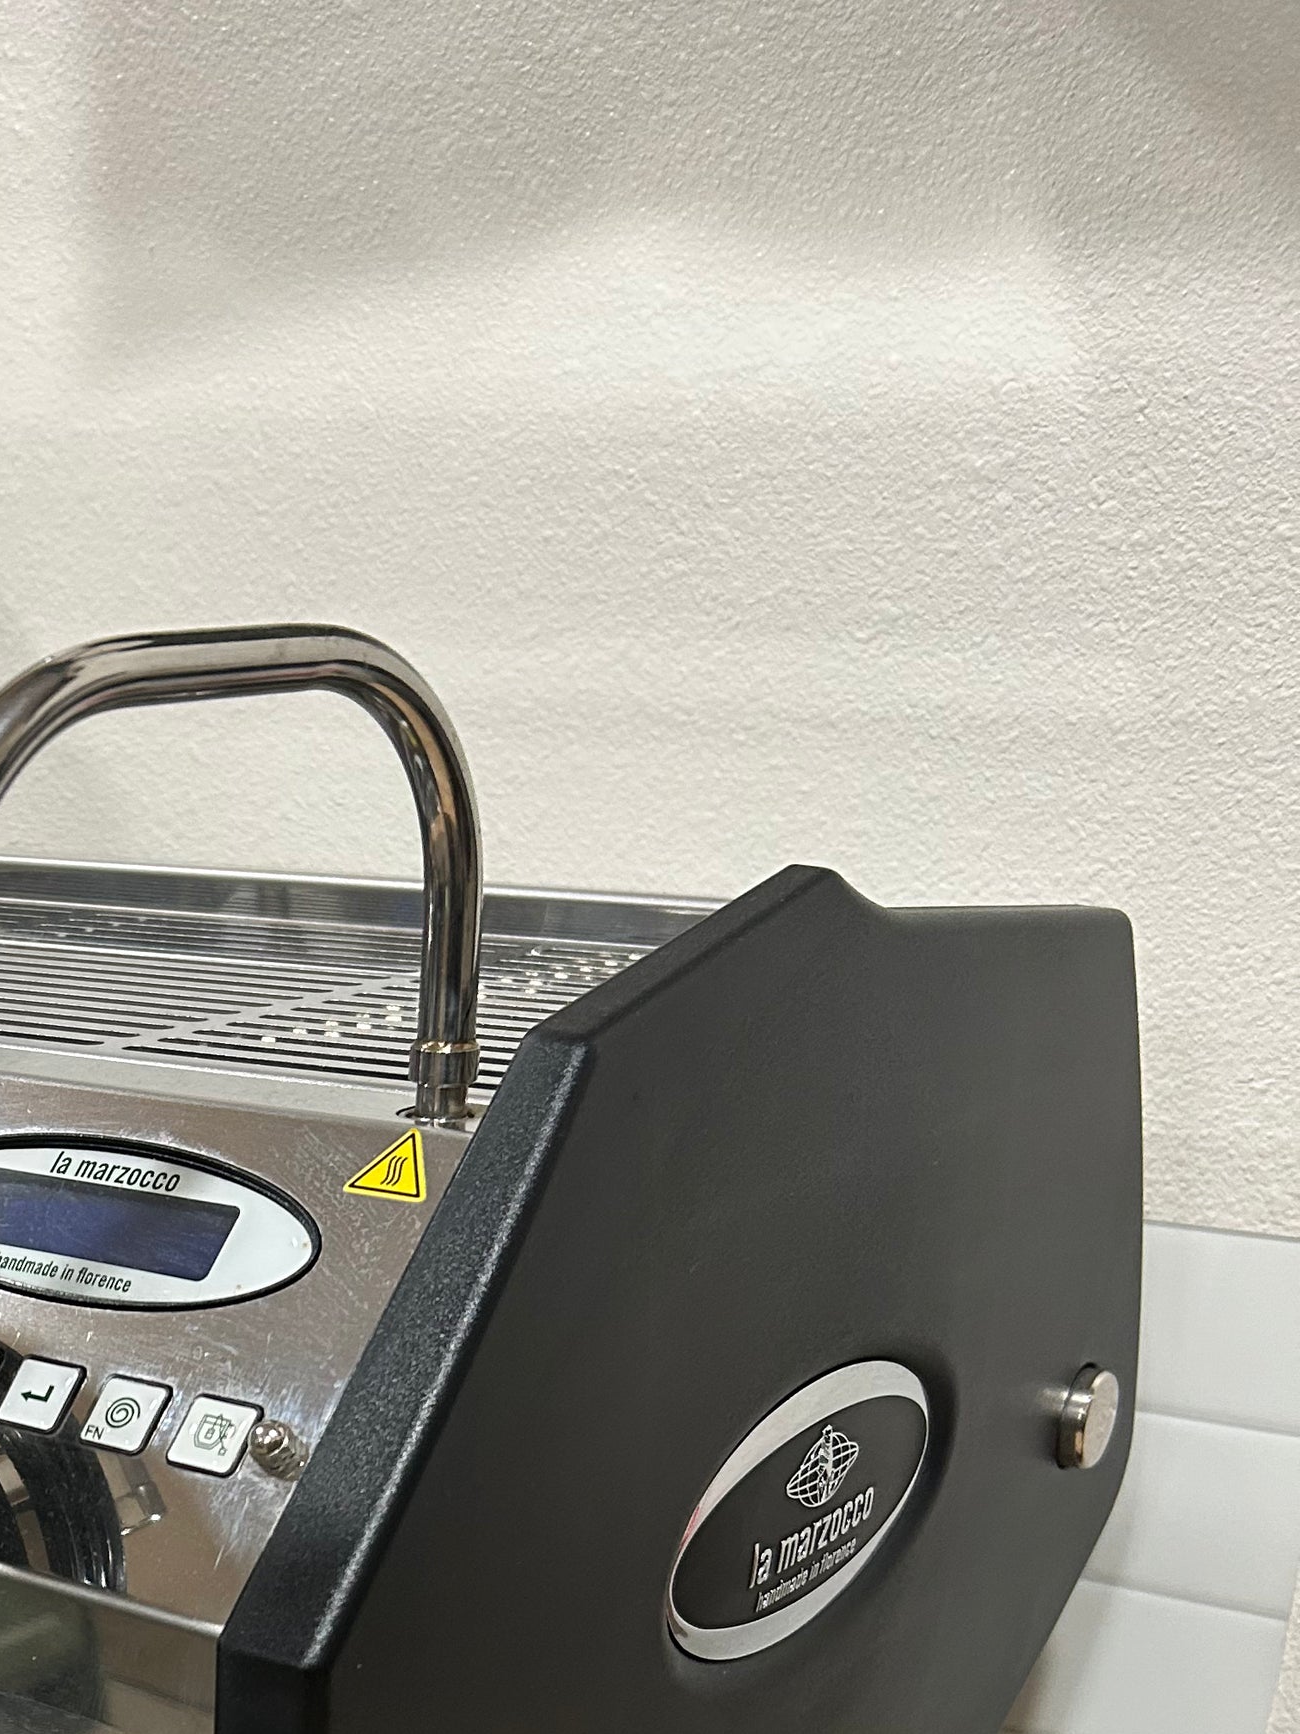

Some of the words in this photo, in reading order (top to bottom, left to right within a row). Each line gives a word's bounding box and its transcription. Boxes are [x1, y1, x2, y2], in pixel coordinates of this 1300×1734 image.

[49, 1150, 76, 1176] la
[74, 1157, 181, 1193] marzocco
[60, 1264, 74, 1281] in
[75, 1266, 133, 1294] florence
[84, 1424, 105, 1440] FN
[748, 1542, 773, 1589] la
[776, 1486, 875, 1574] marzocco
[755, 1567, 809, 1613] handmade
[808, 1560, 820, 1581] in
[819, 1537, 857, 1575] florence
